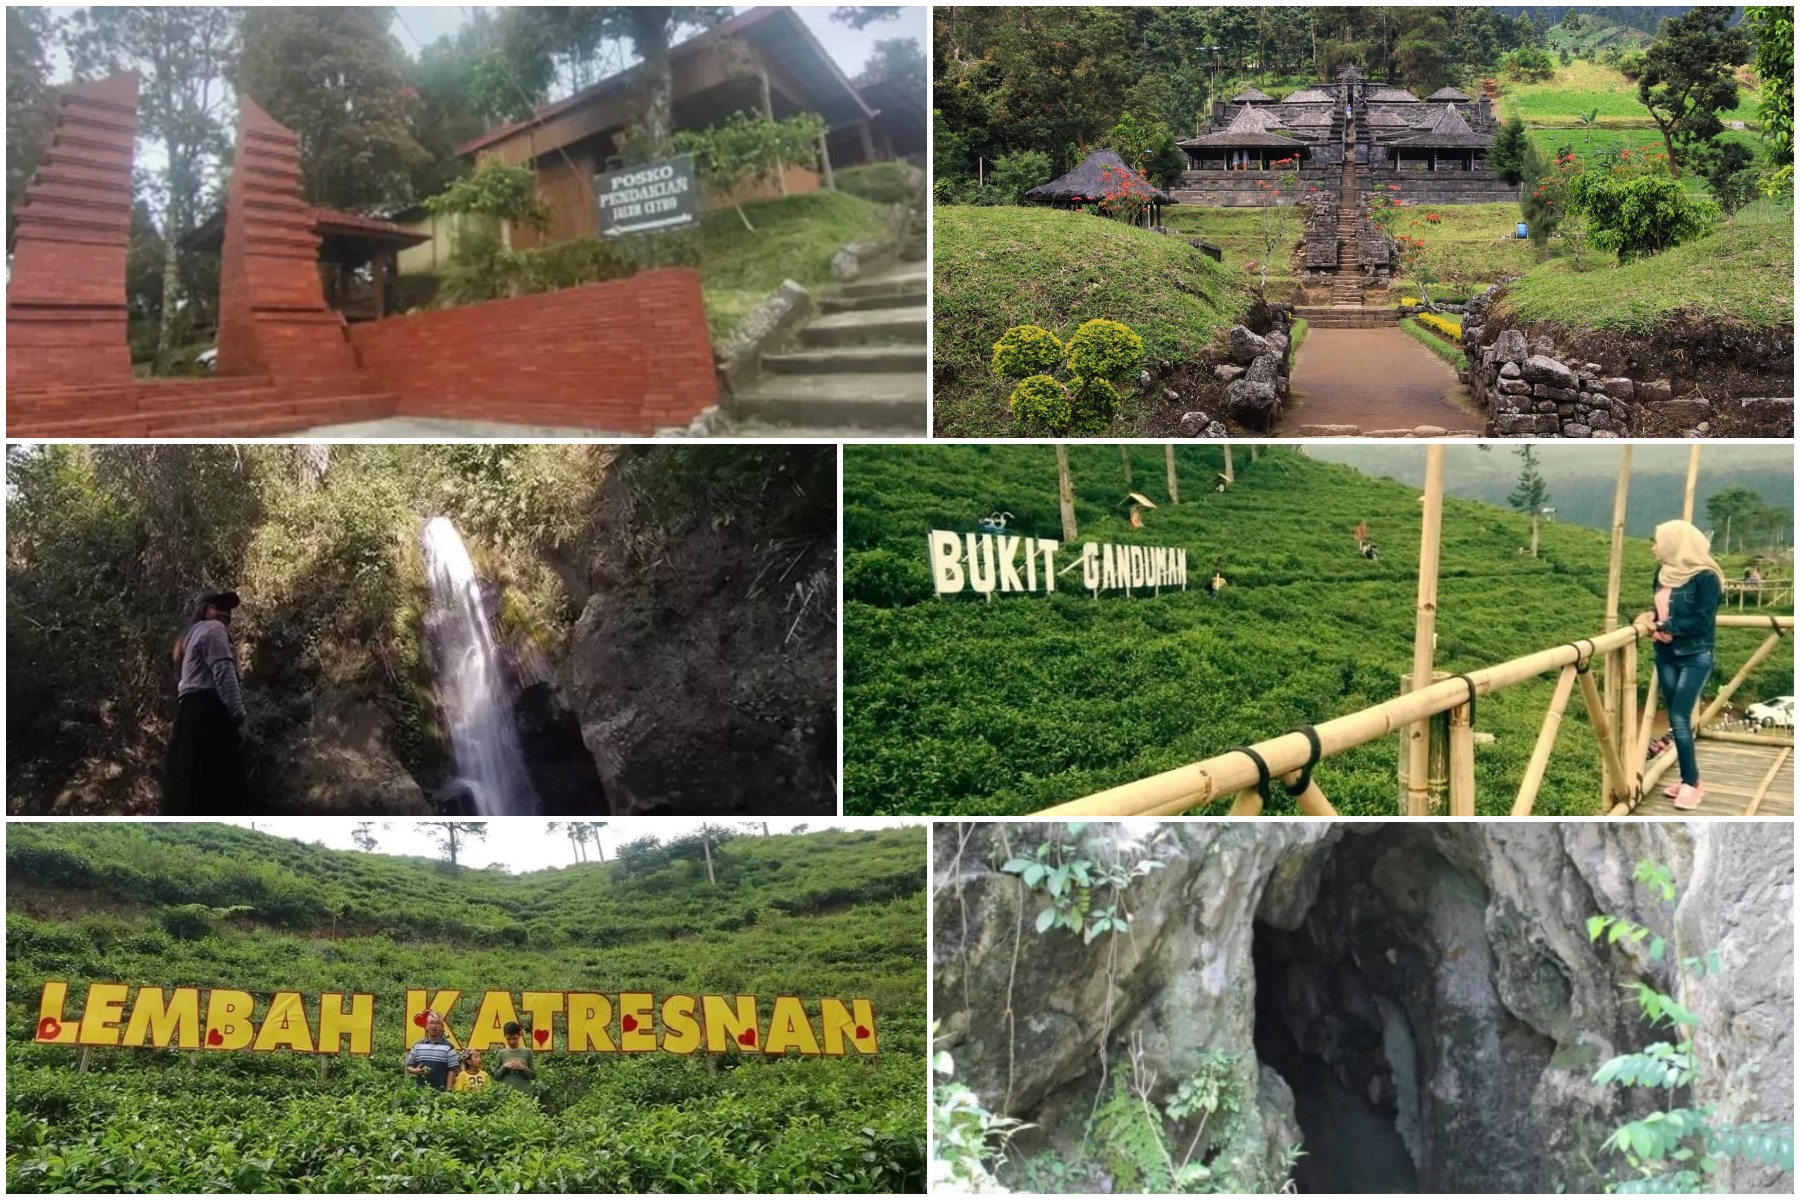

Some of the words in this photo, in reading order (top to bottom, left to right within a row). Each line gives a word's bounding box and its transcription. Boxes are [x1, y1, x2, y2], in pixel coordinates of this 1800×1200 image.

[599, 176, 688, 208] PENDAKIAN
[611, 165, 674, 190] POSKO
[928, 529, 1059, 593] BUKIT
[1082, 541, 1188, 591] GANDUMAN
[34, 981, 375, 1055] LEMBAH
[404, 988, 879, 1055] KATRESNAN
